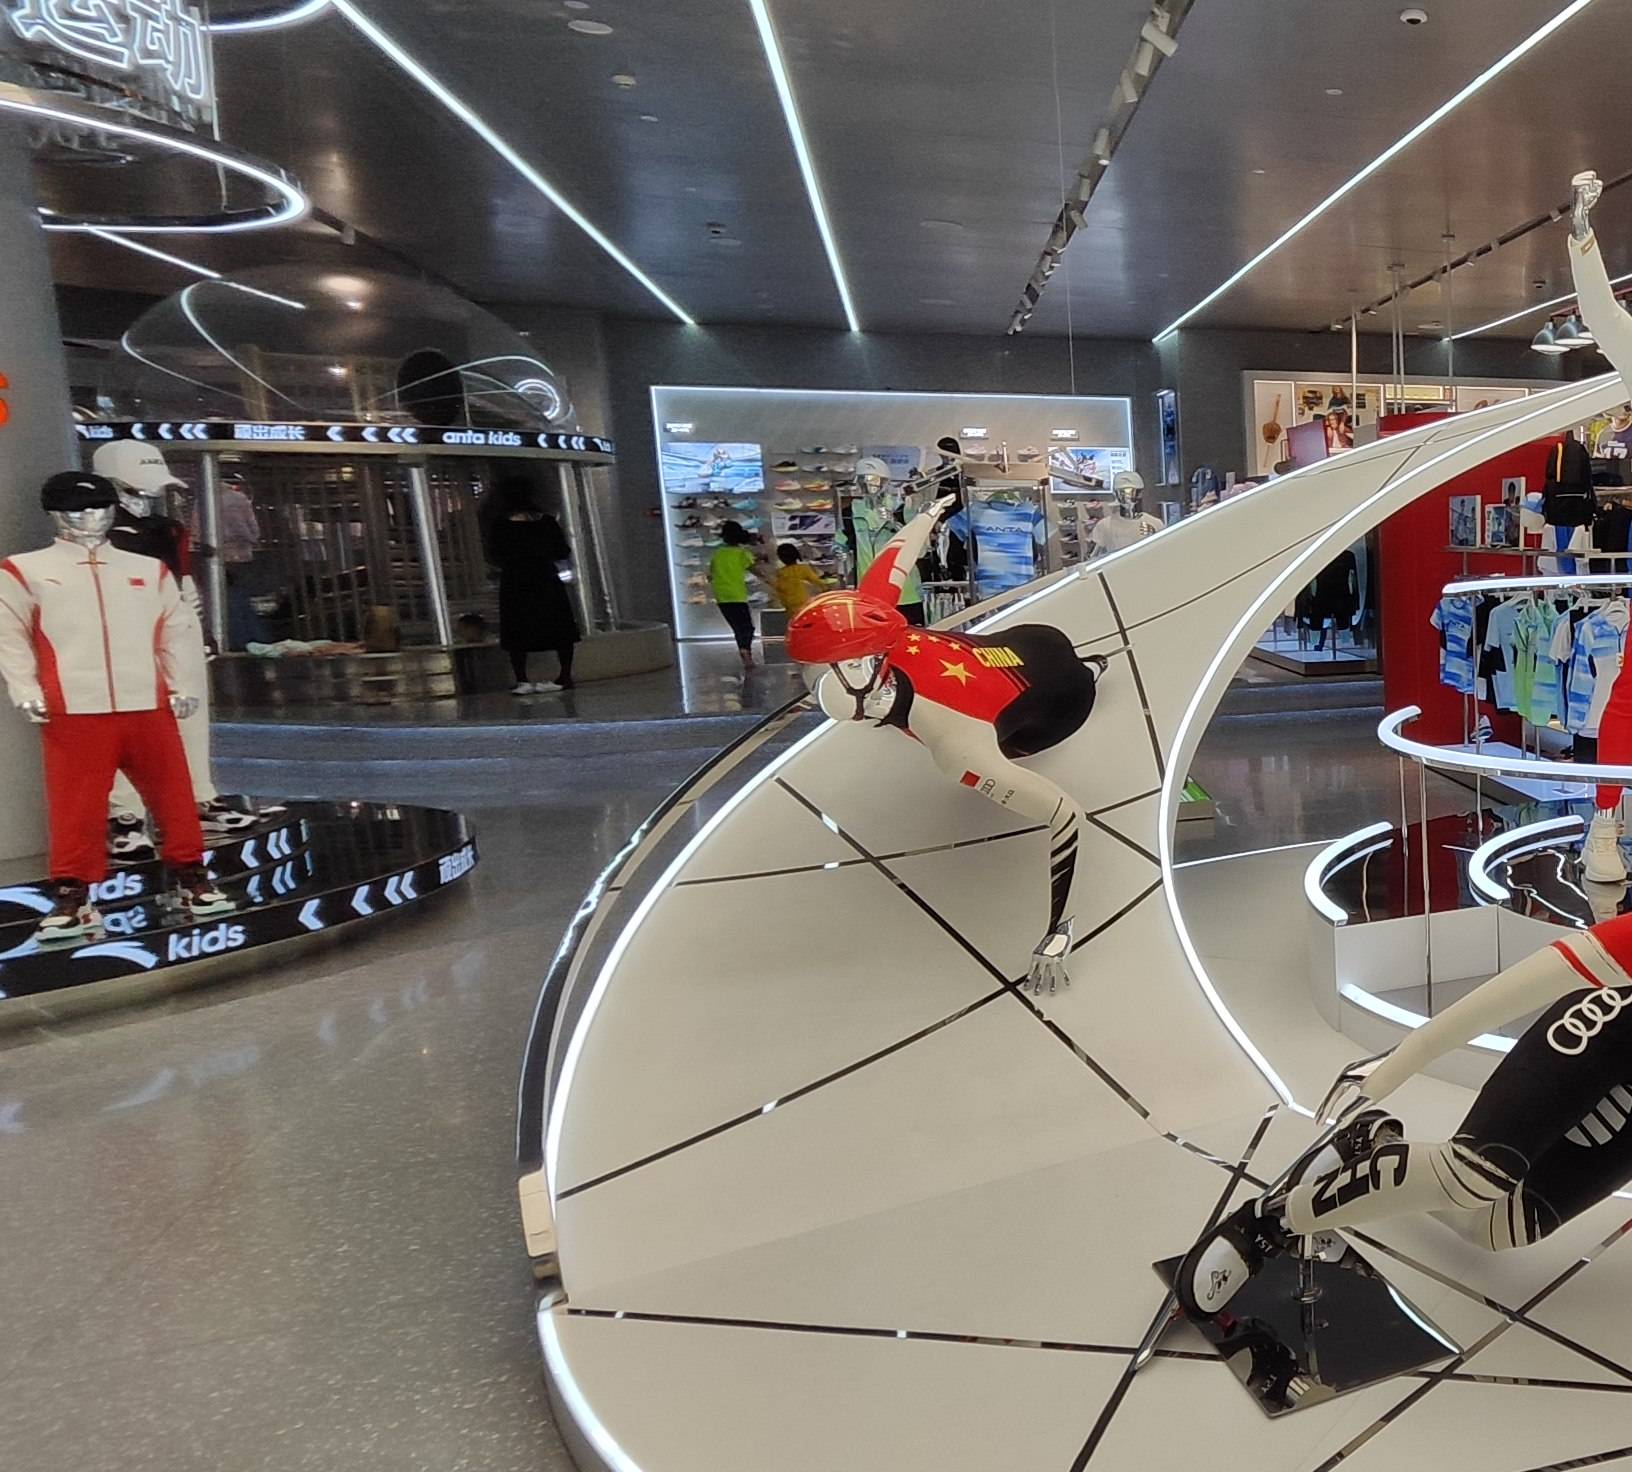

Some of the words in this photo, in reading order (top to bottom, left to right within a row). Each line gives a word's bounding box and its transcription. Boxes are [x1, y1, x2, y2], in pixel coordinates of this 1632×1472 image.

[442, 429, 486, 445] anta
[488, 431, 522, 446] kids
[972, 646, 1025, 668] CHINA
[88, 872, 145, 902] ids
[168, 923, 247, 962] kids
